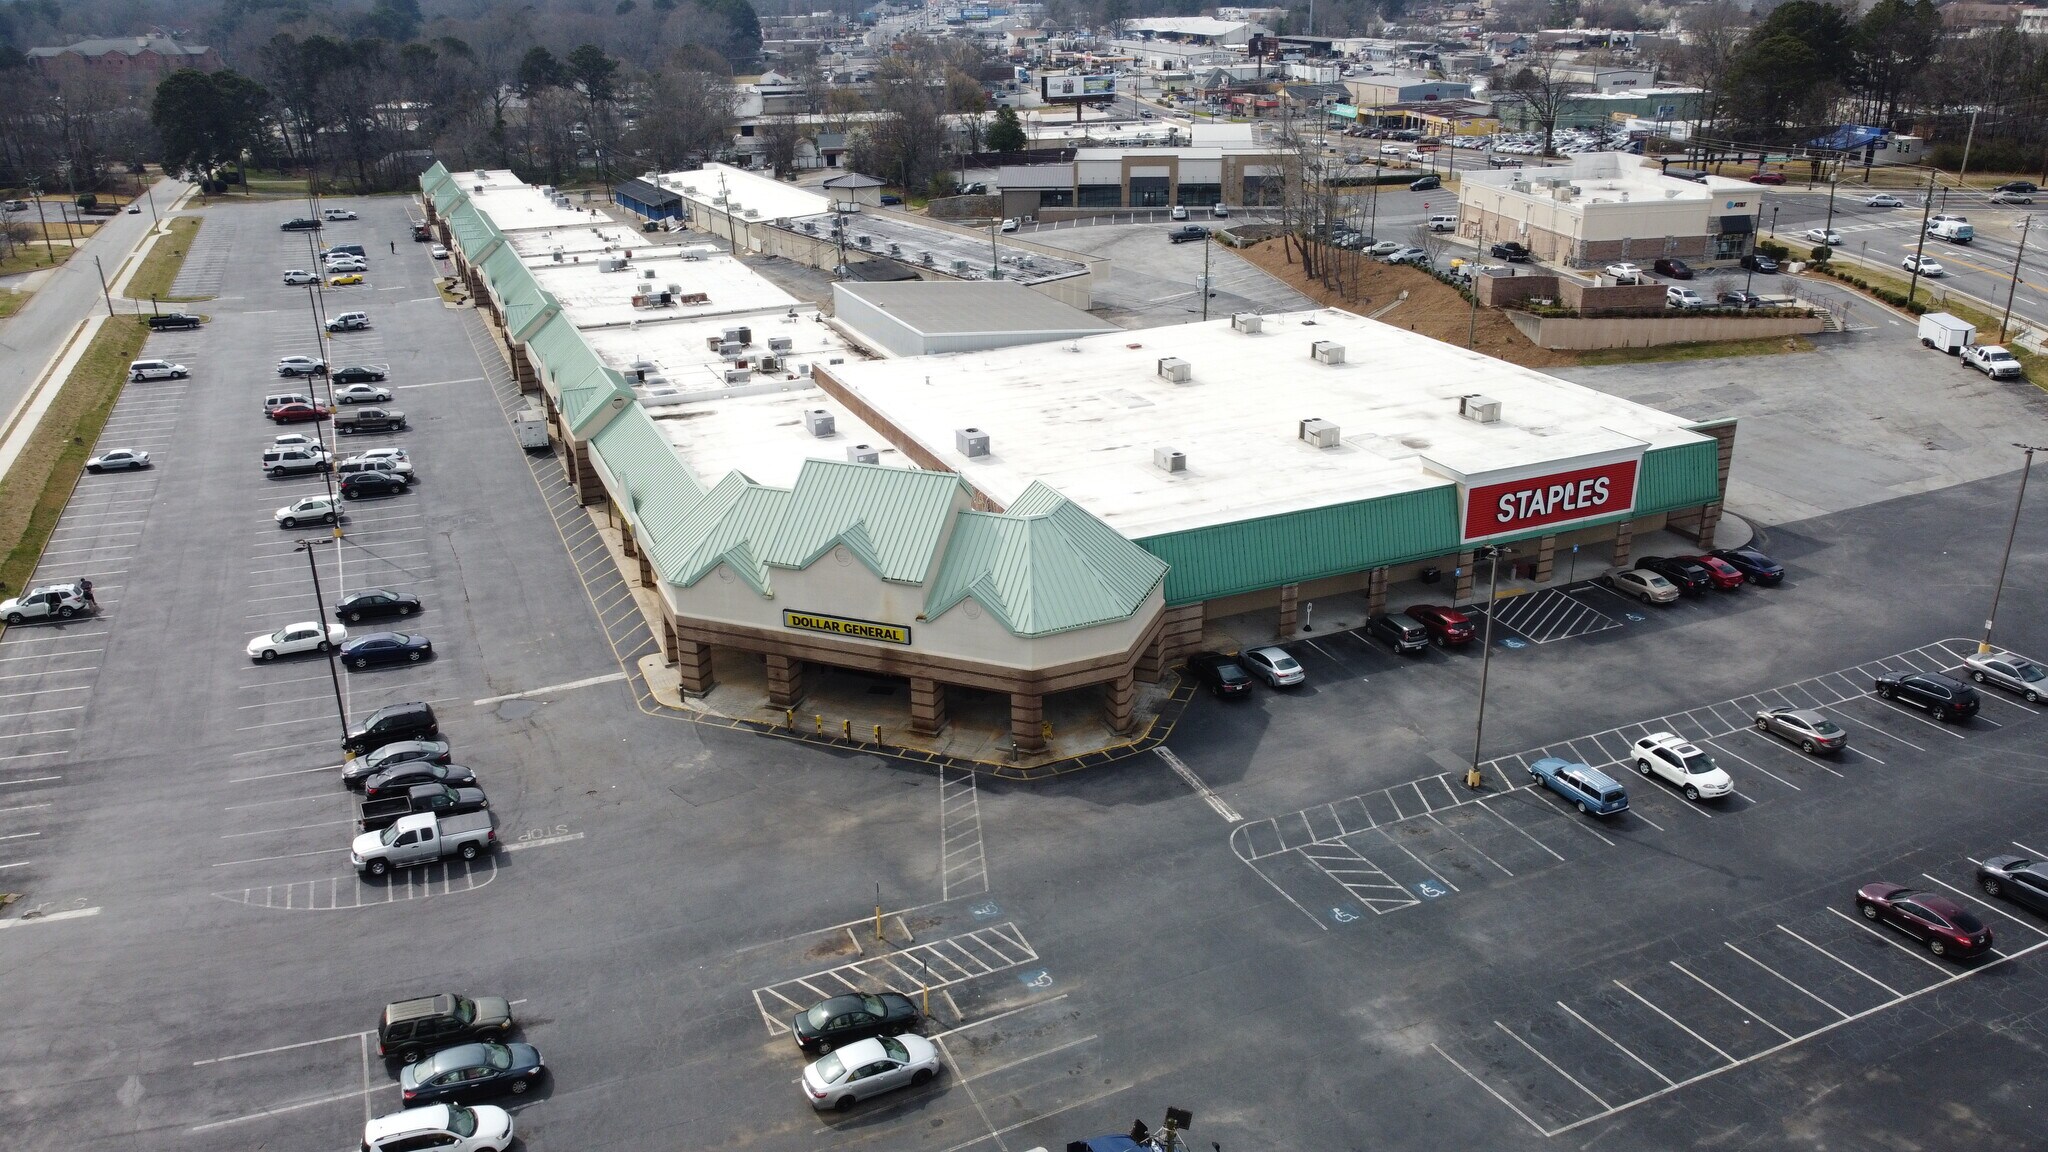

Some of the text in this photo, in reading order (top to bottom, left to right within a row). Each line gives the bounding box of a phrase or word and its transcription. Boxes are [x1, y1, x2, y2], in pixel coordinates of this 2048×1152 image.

[1496, 476, 1610, 523] STAPLES
[791, 615, 900, 641] DOLLAR GENERAL
[518, 824, 569, 842] STOP
